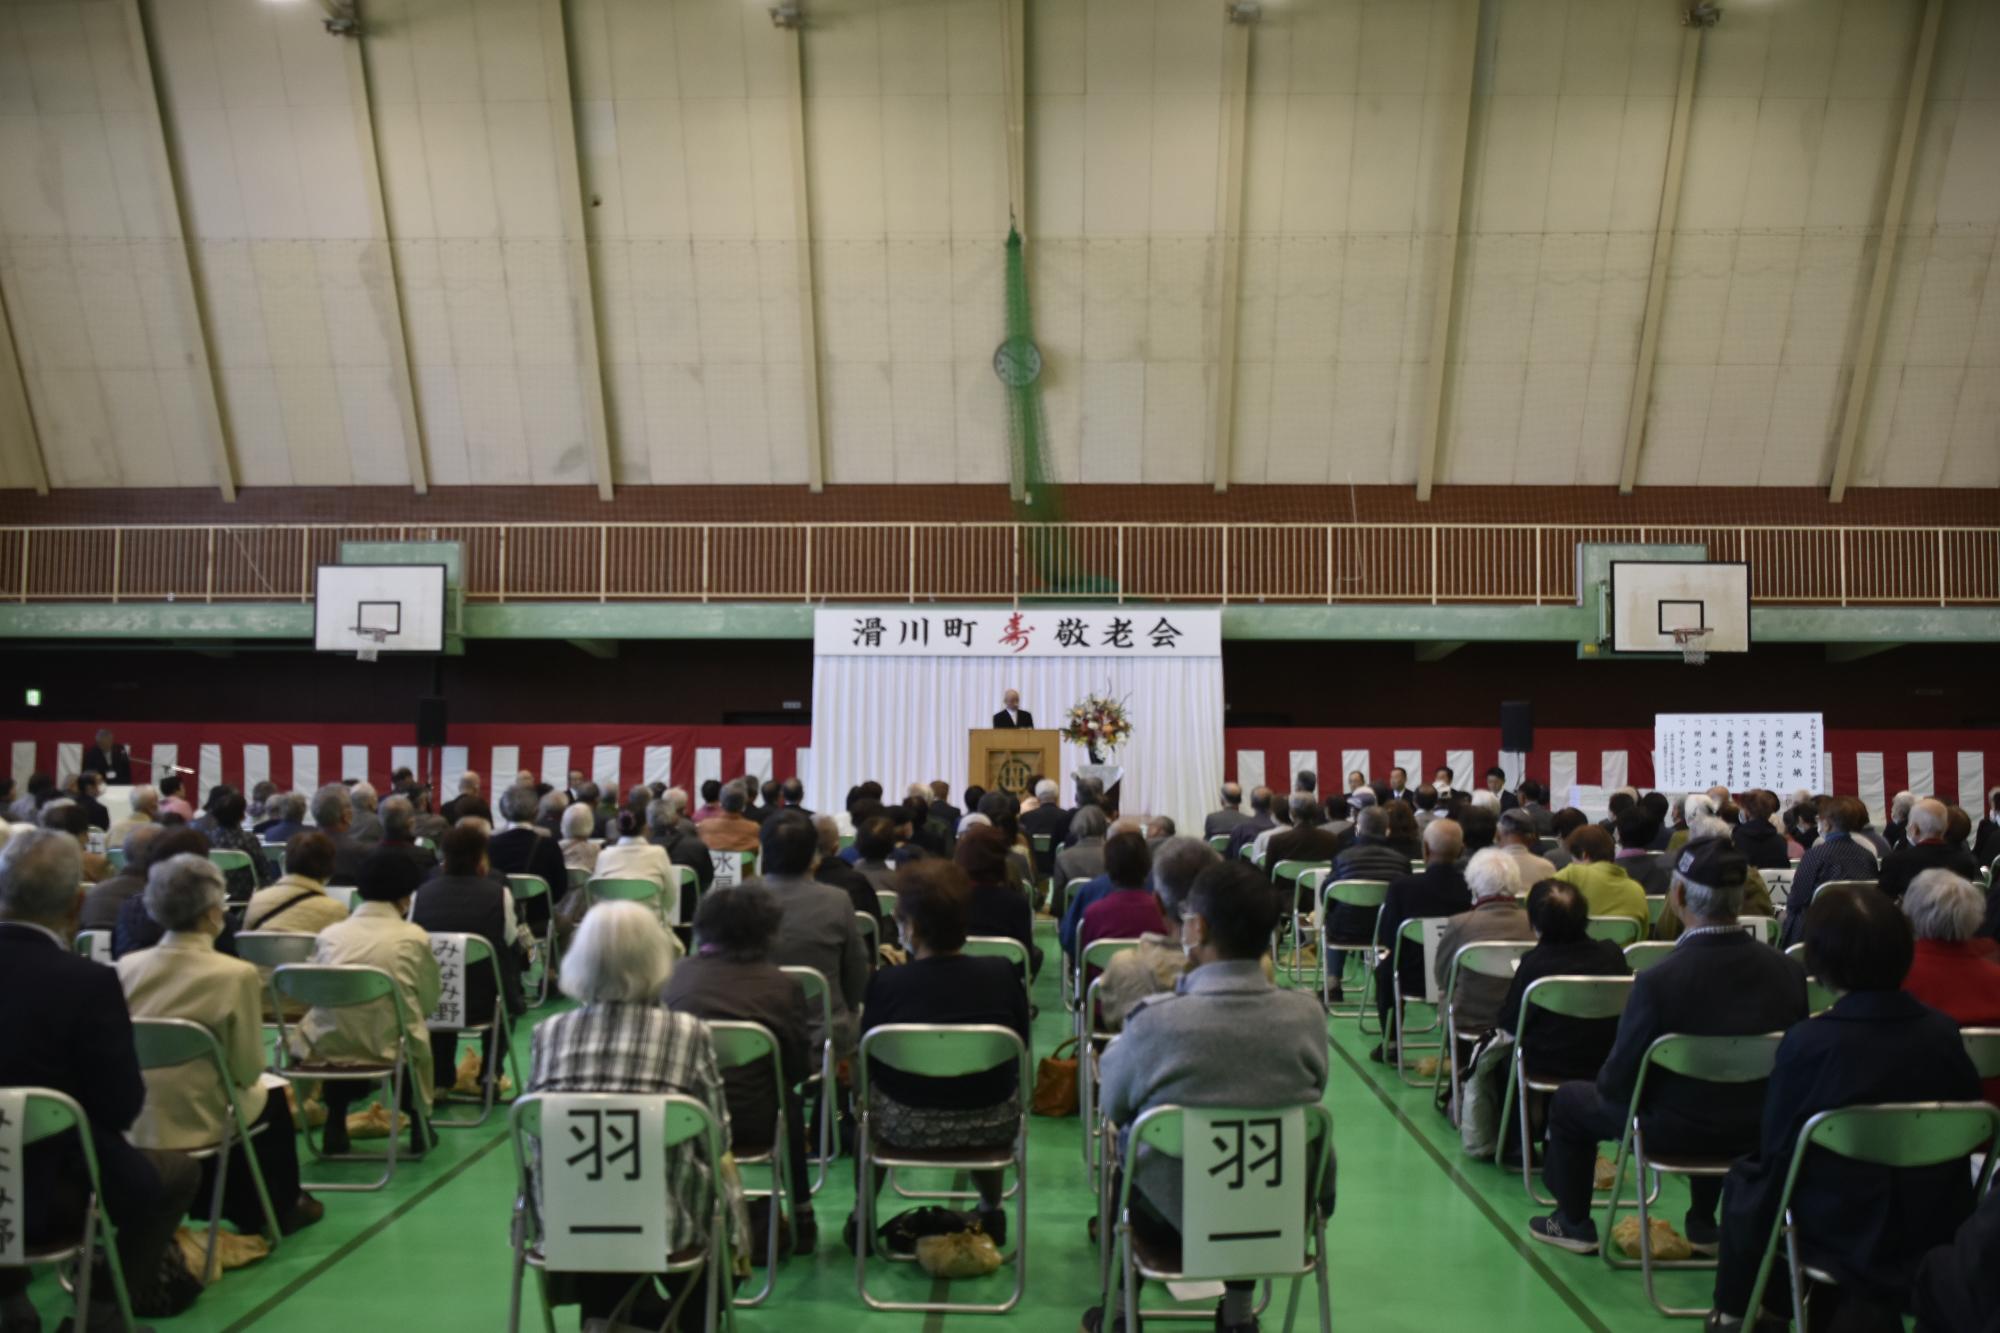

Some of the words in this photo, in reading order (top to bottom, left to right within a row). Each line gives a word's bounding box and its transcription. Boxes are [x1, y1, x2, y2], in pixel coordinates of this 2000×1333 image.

[852, 616, 979, 648] 滑川町
[998, 611, 1035, 653] 寿
[1054, 616, 1183, 649] 敬老会
